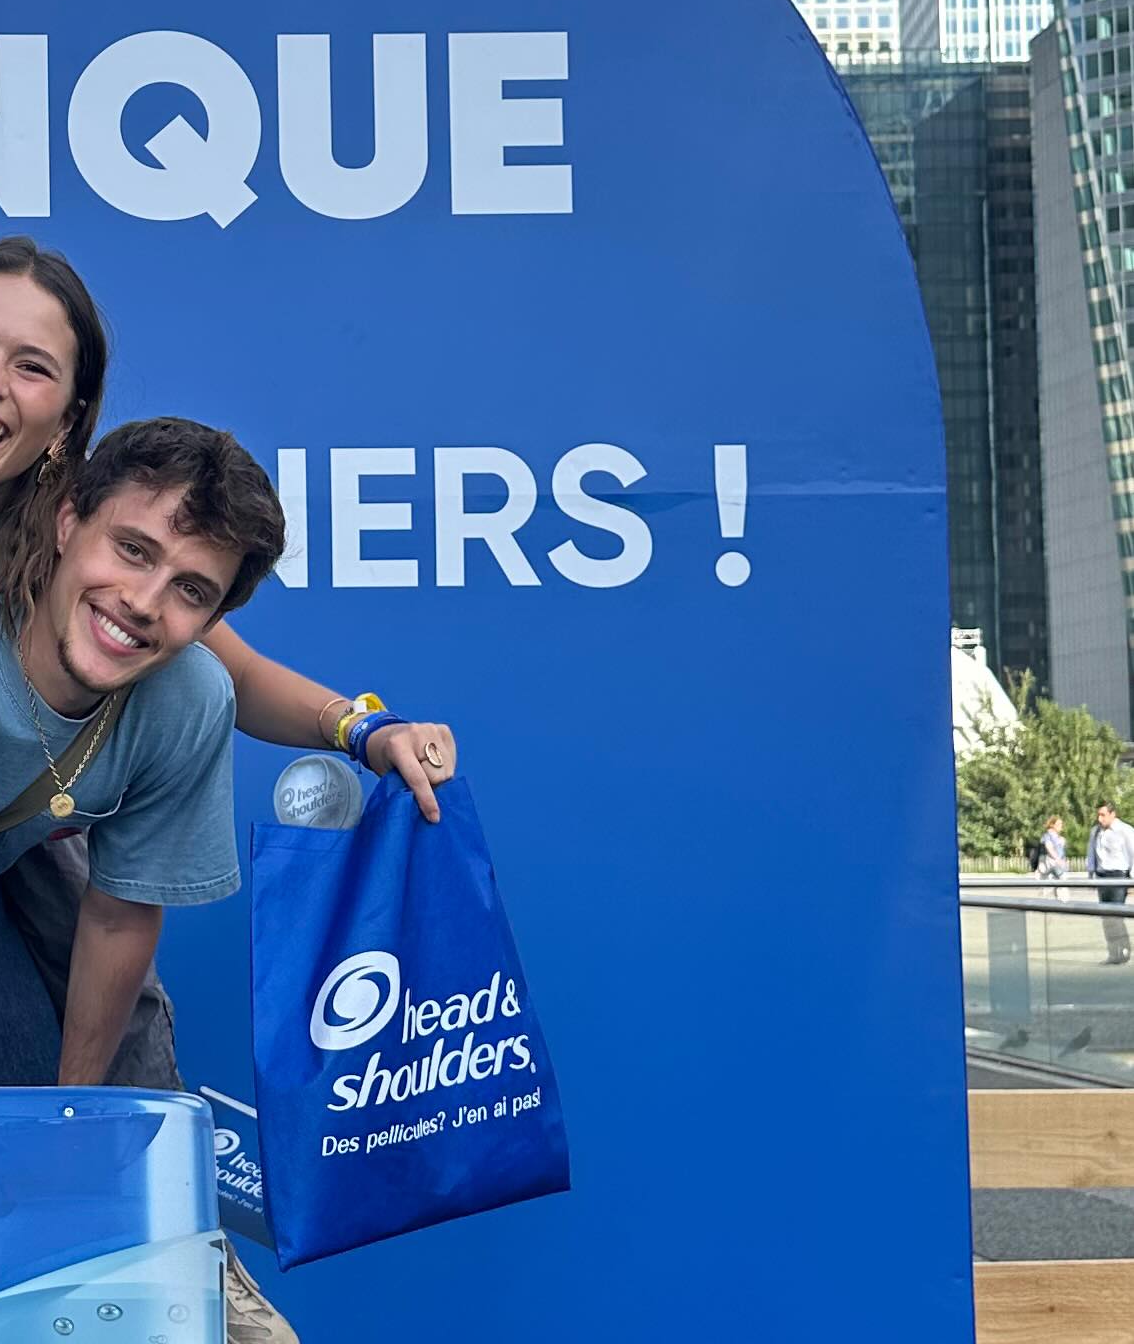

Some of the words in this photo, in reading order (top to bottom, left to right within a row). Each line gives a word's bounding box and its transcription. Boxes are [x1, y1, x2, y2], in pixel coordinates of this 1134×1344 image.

[714, 444, 752, 588] !
[401, 970, 501, 1044] head
[501, 978, 522, 1017] &
[321, 1136, 360, 1157] Des
[366, 1111, 447, 1154] pellicules?
[452, 1105, 488, 1128] J'en
[493, 1096, 507, 1118] ai
[229, 1151, 262, 1179] hea
